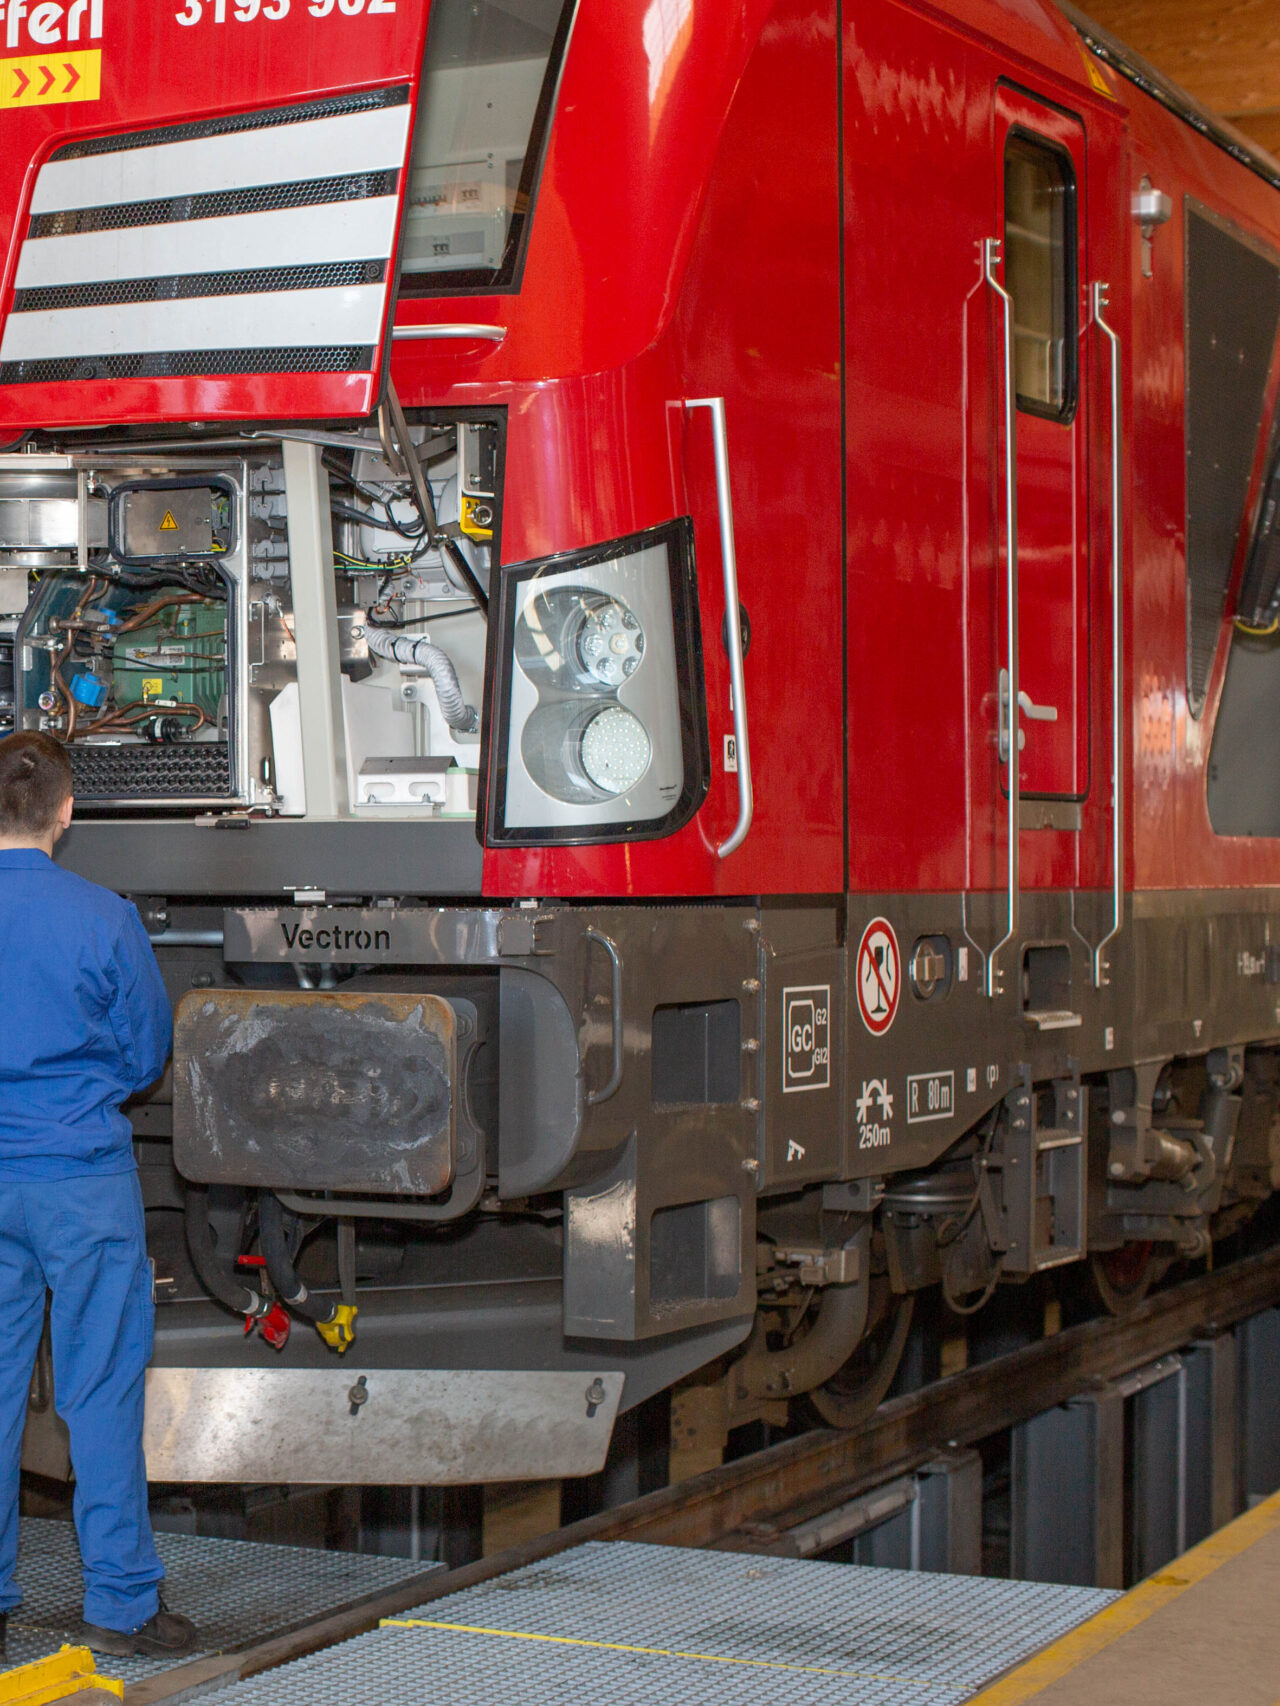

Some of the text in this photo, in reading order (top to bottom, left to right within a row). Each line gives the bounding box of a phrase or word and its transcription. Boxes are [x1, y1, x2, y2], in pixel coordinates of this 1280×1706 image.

[281, 923, 391, 950] Vectron
[815, 1008, 827, 1025] G2
[791, 1024, 812, 1052] GC
[911, 1082, 919, 1112] R
[859, 1123, 890, 1149] 250m
